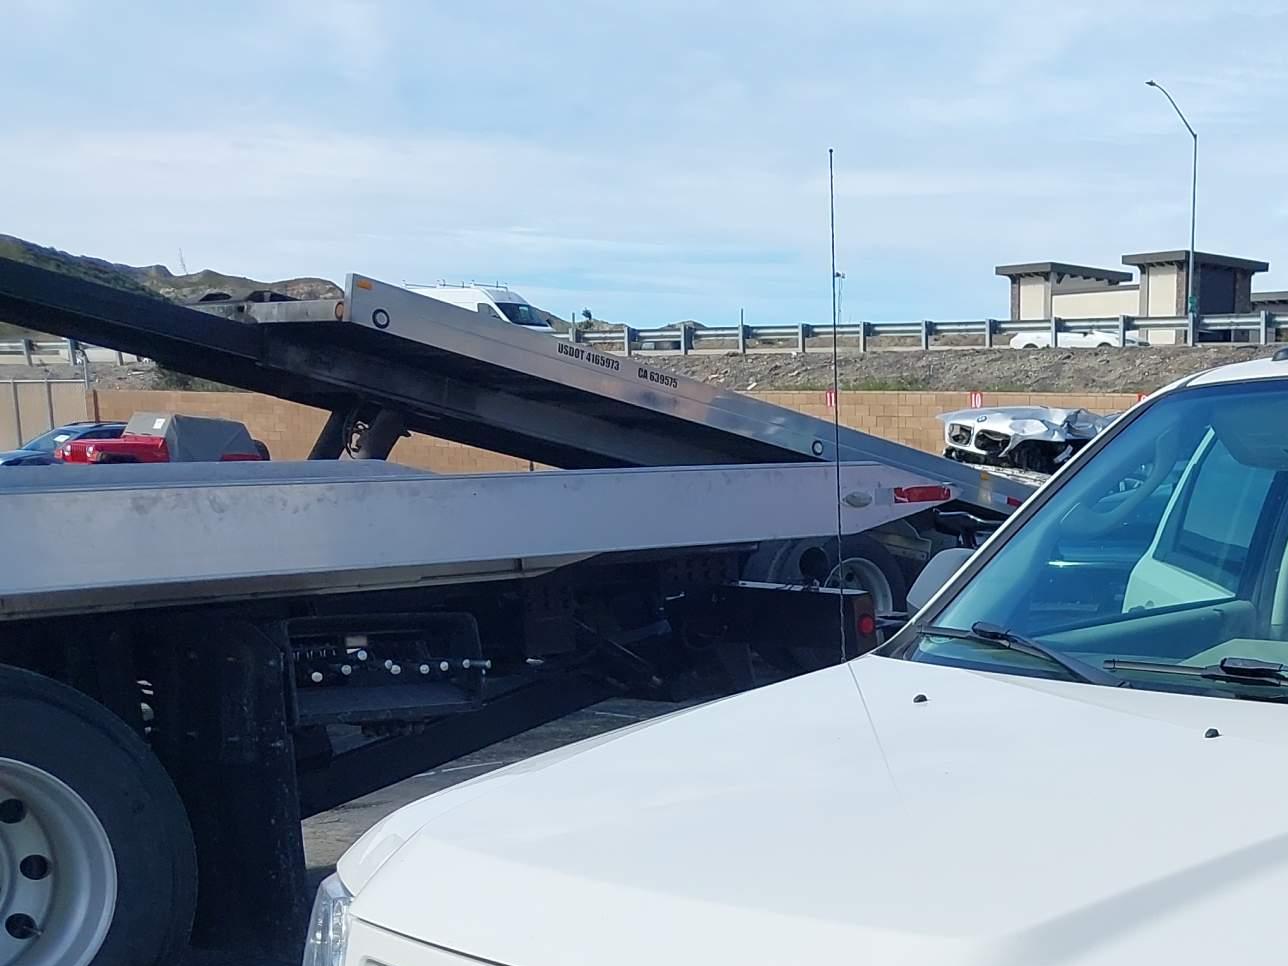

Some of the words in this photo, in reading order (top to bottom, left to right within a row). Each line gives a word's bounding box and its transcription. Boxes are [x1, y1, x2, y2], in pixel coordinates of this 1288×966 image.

[558, 343, 585, 361] USDOT
[586, 352, 620, 371] 4165973
[638, 367, 648, 380] CA
[649, 371, 678, 388] 639575
[827, 392, 835, 407] 11
[972, 393, 982, 408] 10
